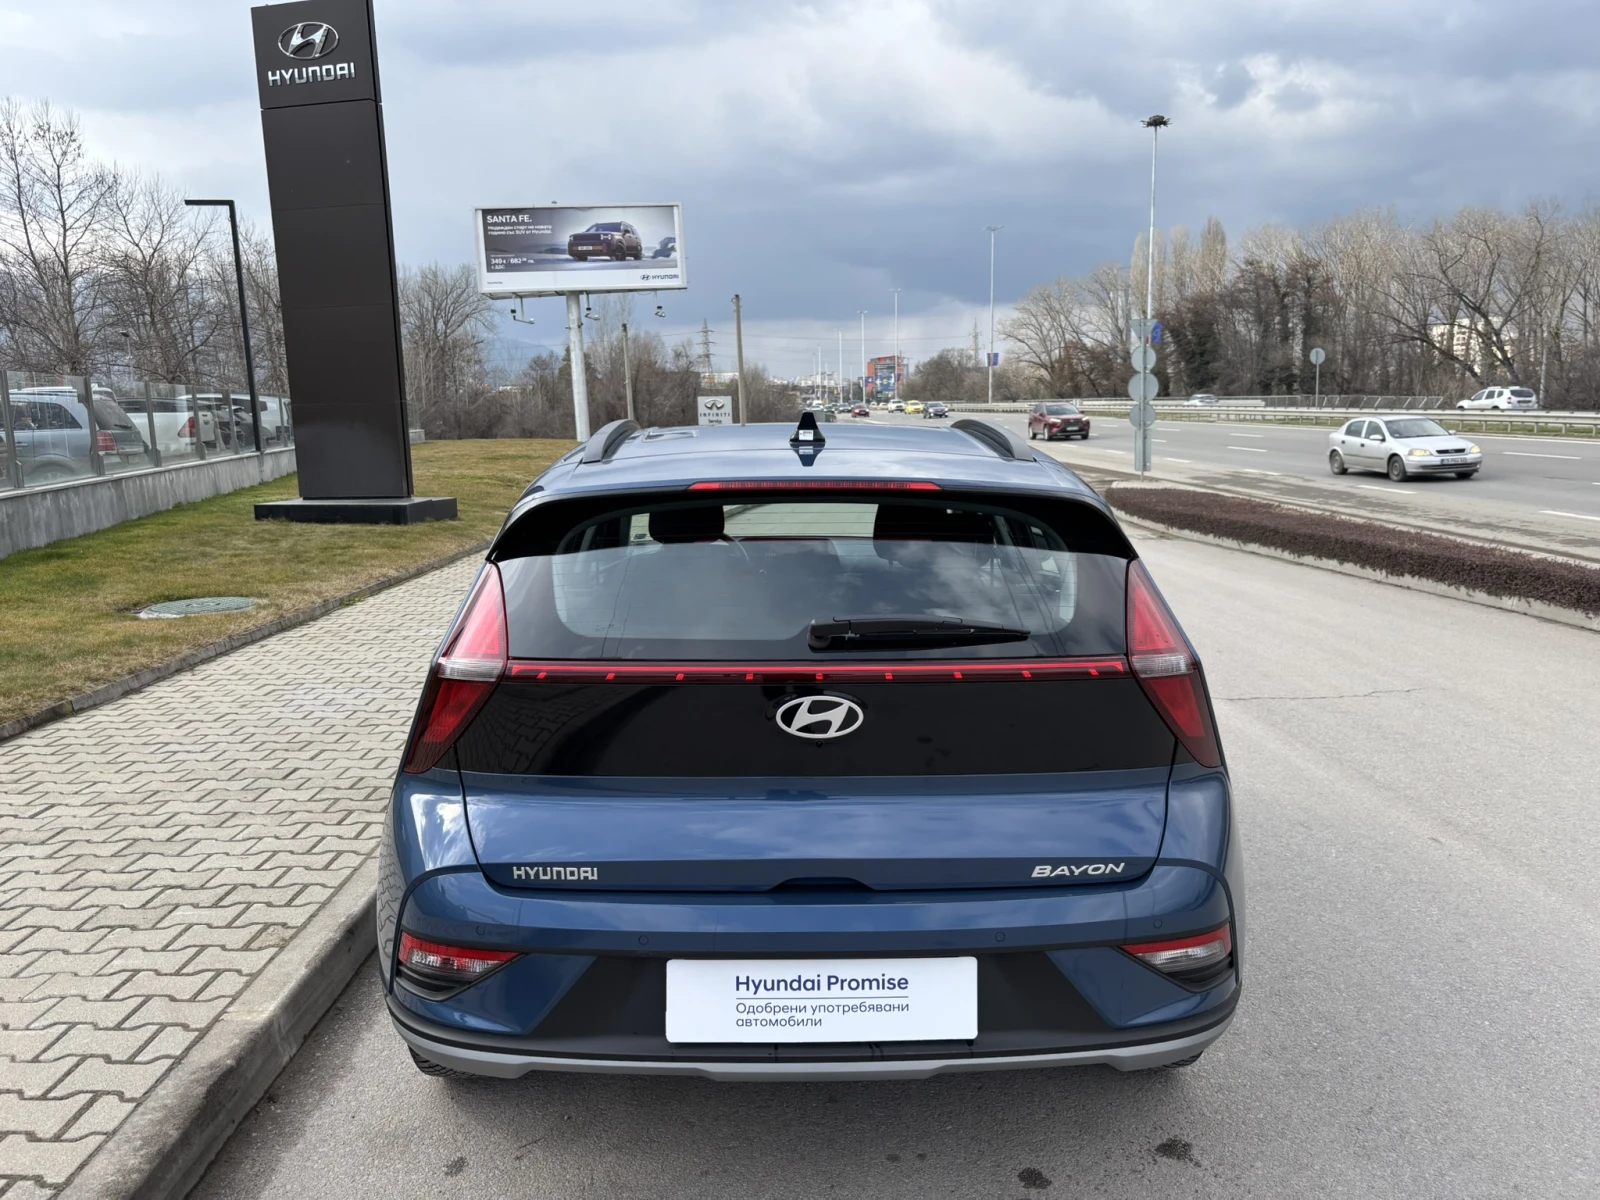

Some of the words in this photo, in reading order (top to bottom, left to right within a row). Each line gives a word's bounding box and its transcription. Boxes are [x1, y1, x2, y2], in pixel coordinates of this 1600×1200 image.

[267, 62, 356, 86] HYUNDAI
[487, 215, 518, 223] SANTA
[519, 214, 532, 222] FE.
[513, 866, 598, 880] HYUNDAI
[1031, 862, 1125, 878] BAYON
[735, 974, 821, 995] Hyundai
[827, 973, 909, 991] Promise
[736, 1002, 807, 1016] Одобрени
[811, 1001, 910, 1016] употребявани
[736, 1015, 822, 1027] автомобили
